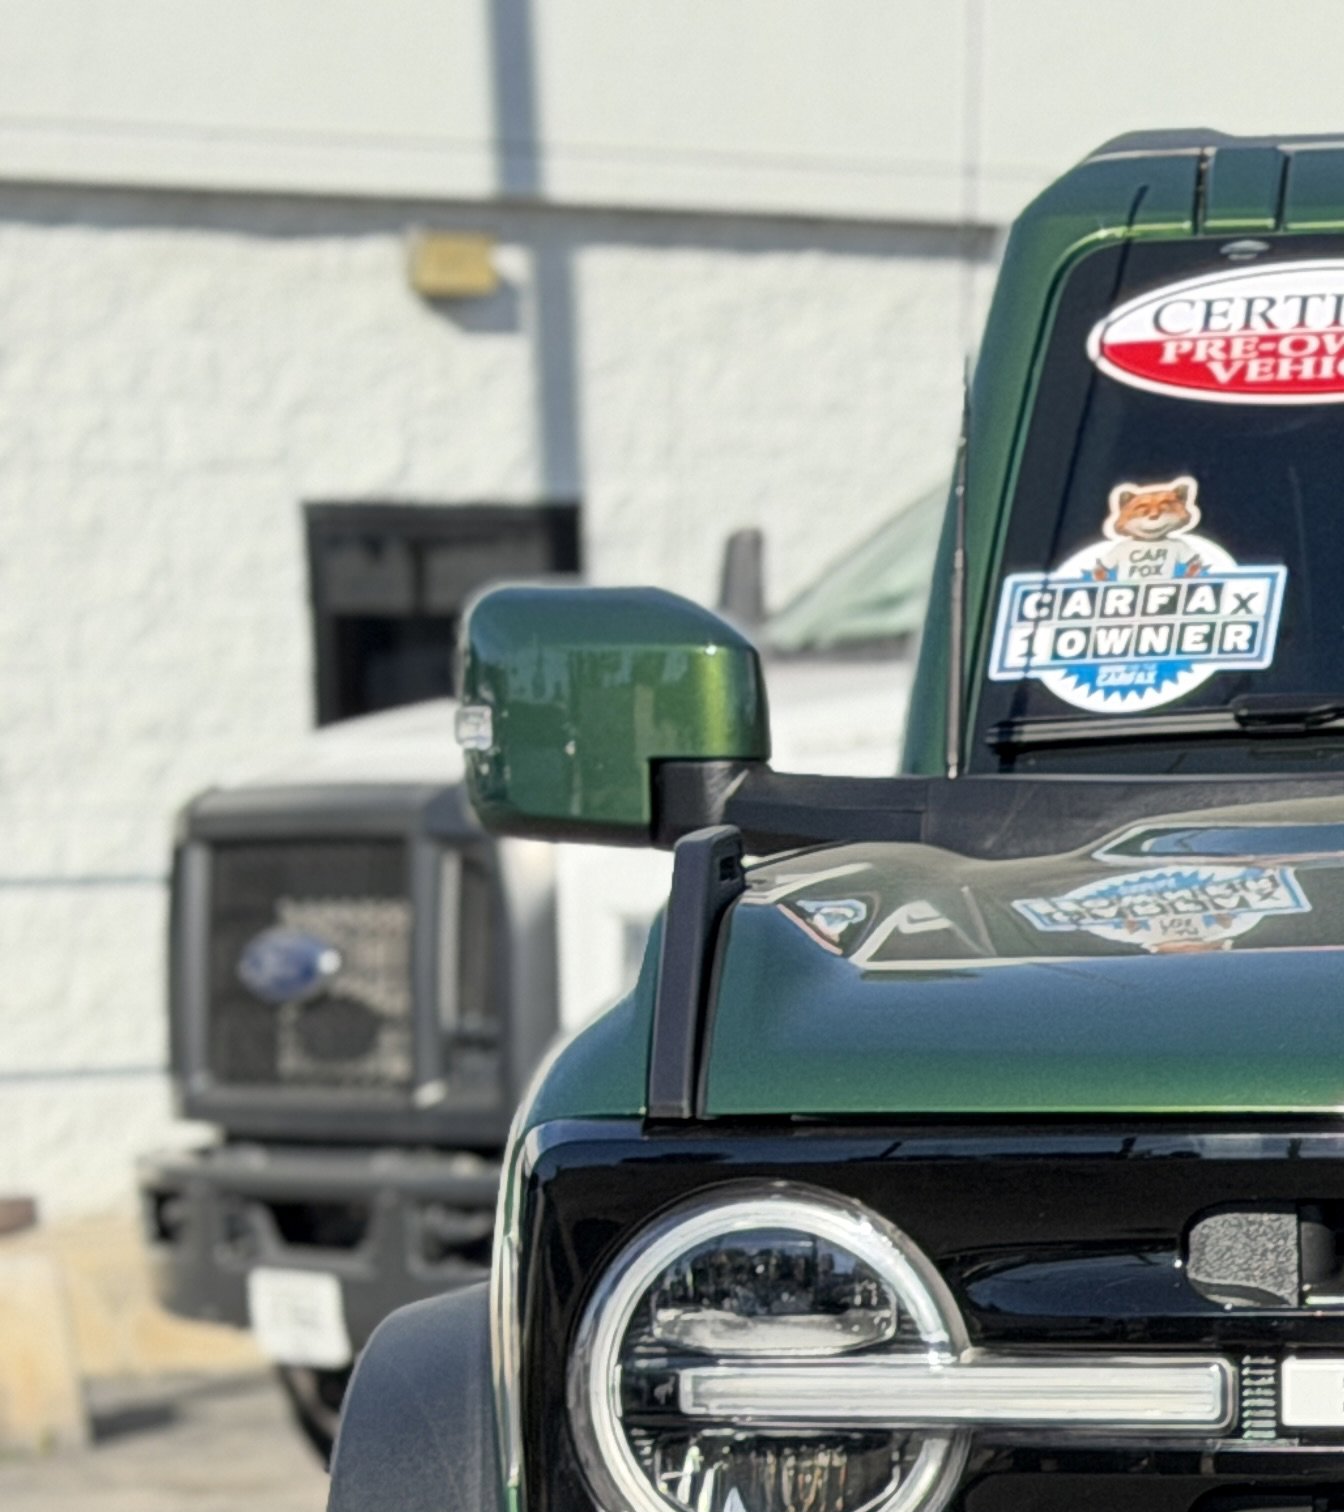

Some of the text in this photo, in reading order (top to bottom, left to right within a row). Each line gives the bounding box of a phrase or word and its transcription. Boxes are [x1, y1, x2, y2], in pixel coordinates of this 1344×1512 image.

[1128, 548, 1168, 564] CAR
[1128, 565, 1163, 578] FOX
[1022, 585, 1258, 619] CARFAX
